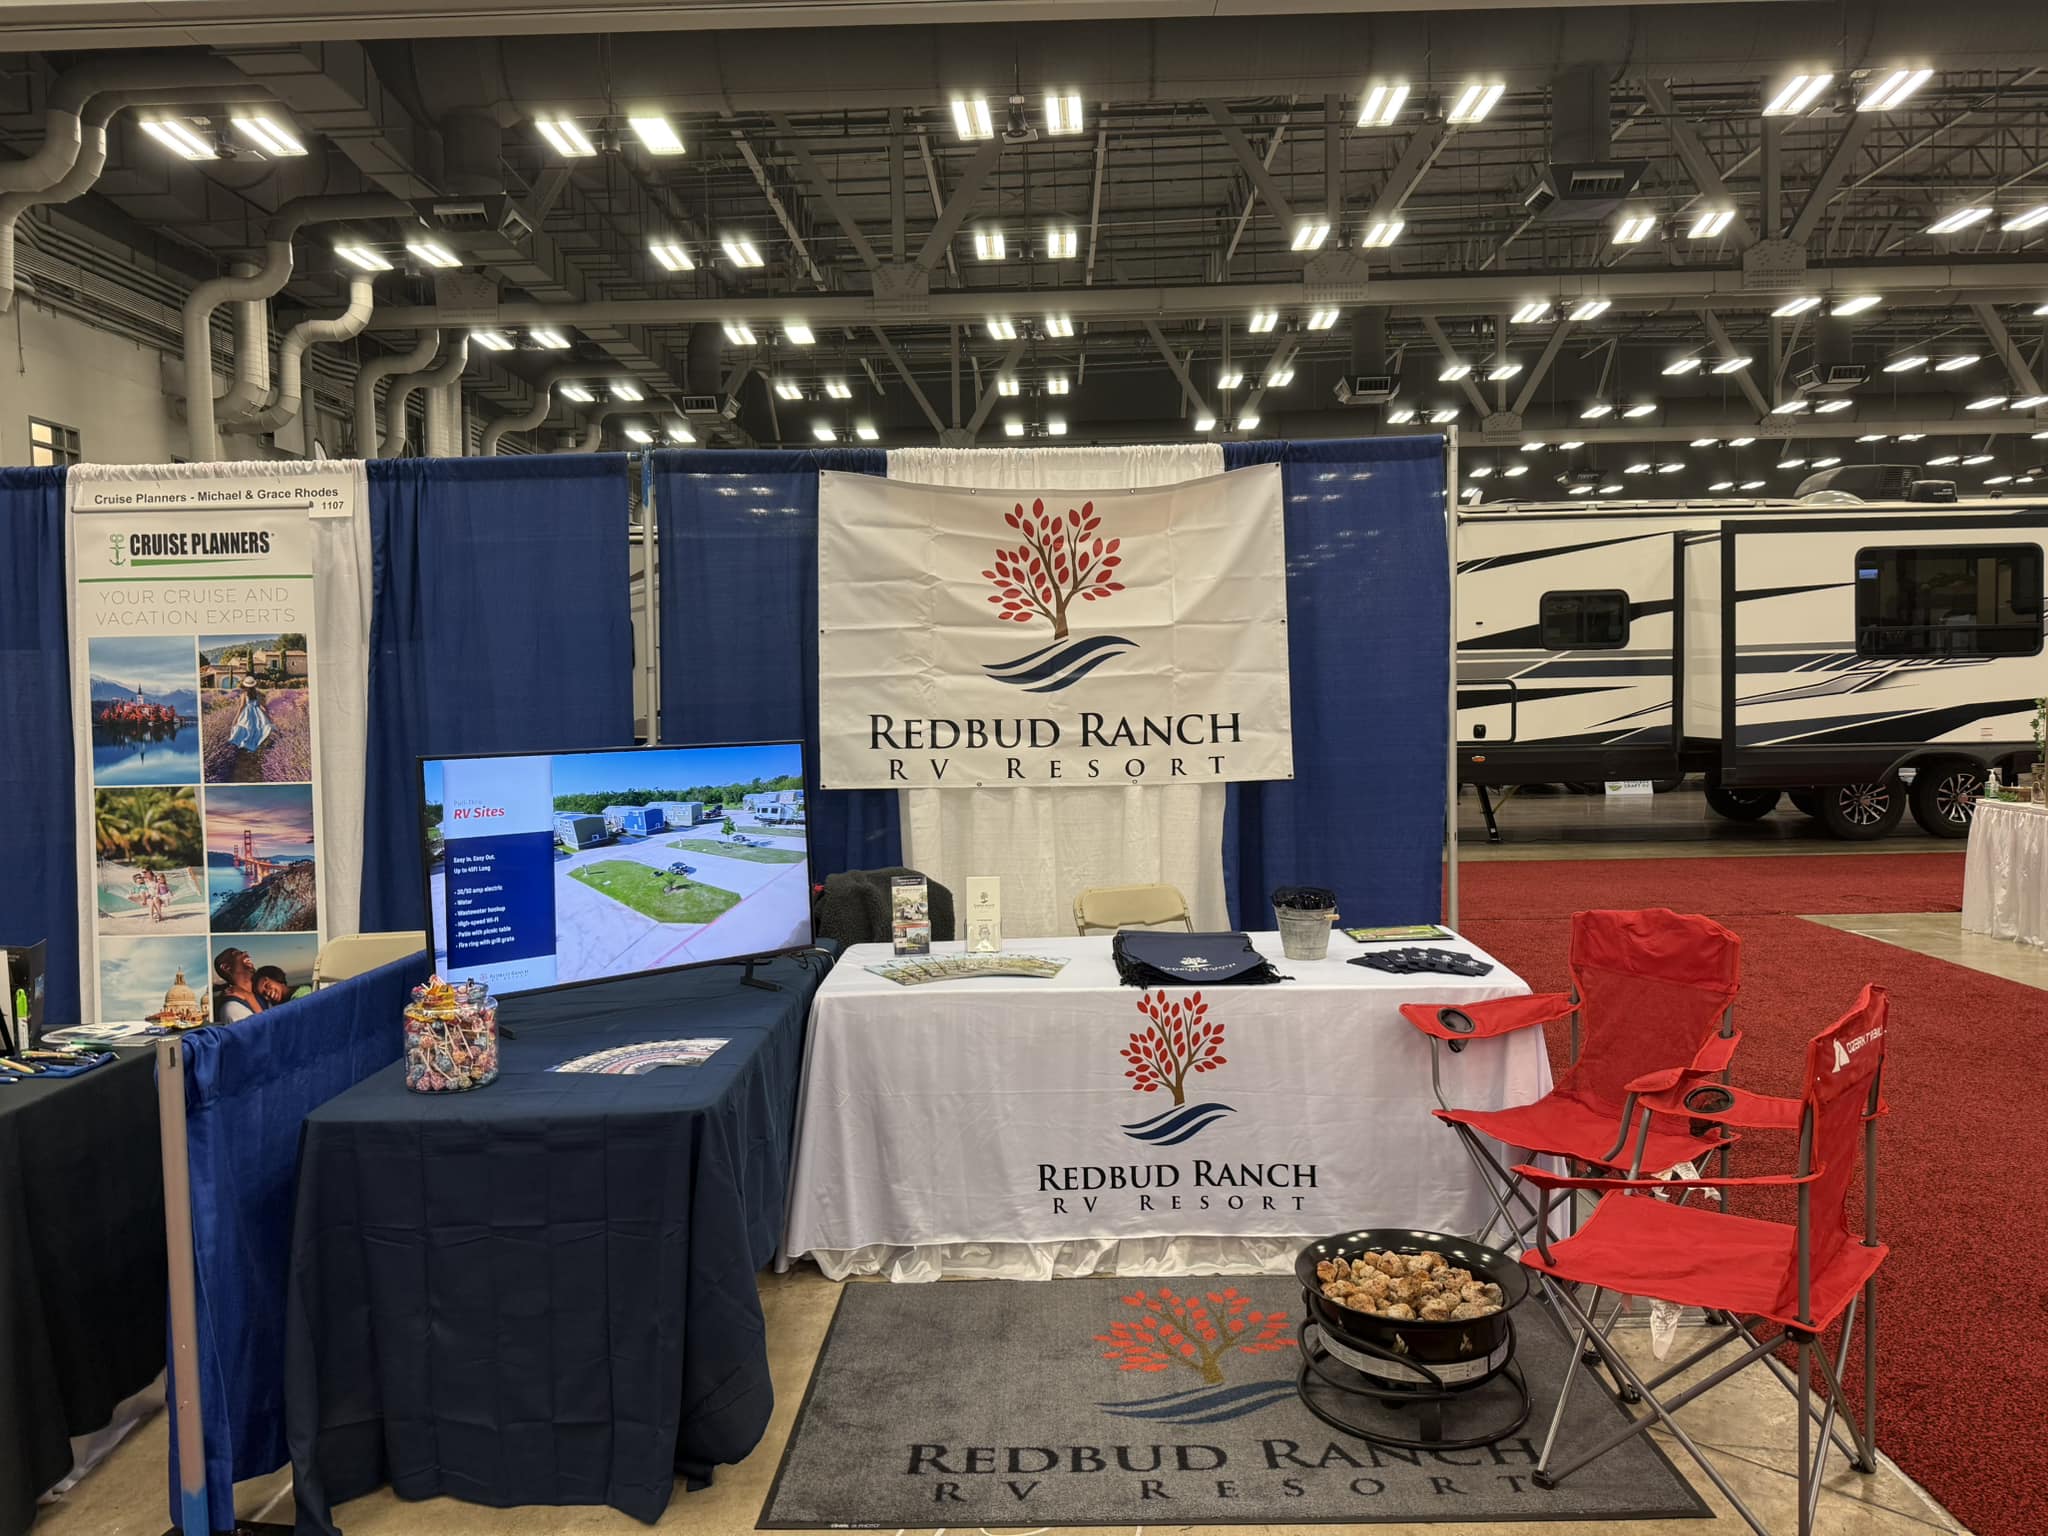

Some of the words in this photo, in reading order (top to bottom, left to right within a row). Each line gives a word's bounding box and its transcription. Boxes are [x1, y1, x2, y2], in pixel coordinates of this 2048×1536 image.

[94, 493, 132, 505] Cruise
[136, 492, 187, 504] Planners
[198, 490, 242, 502] Michael
[245, 489, 254, 500] &
[257, 488, 292, 500] Grace
[294, 487, 339, 498] Rhodes
[322, 501, 344, 510] 1107
[130, 533, 188, 556] CRUISE
[191, 531, 270, 555] PLANNERS
[99, 589, 154, 605] YOUR
[164, 588, 237, 604] CRUISE
[246, 587, 289, 603] AND
[96, 610, 198, 626] VACATION
[207, 608, 296, 624] EXPERTS
[868, 713, 1060, 750] REDBUD
[1078, 712, 1243, 747] RANCH
[889, 758, 949, 781] RV
[1006, 755, 1226, 780] RESORT
[454, 808, 471, 820] RV
[473, 805, 505, 818] Sites
[1037, 1163, 1179, 1191] REDBUD
[1192, 1159, 1318, 1188] RANCH
[1053, 1196, 1098, 1214] RV
[1140, 1194, 1305, 1211] RESORT
[902, 1444, 1228, 1475] REDBUD
[933, 1481, 1042, 1501] RV
[1139, 1475, 1527, 1500] RESORT
